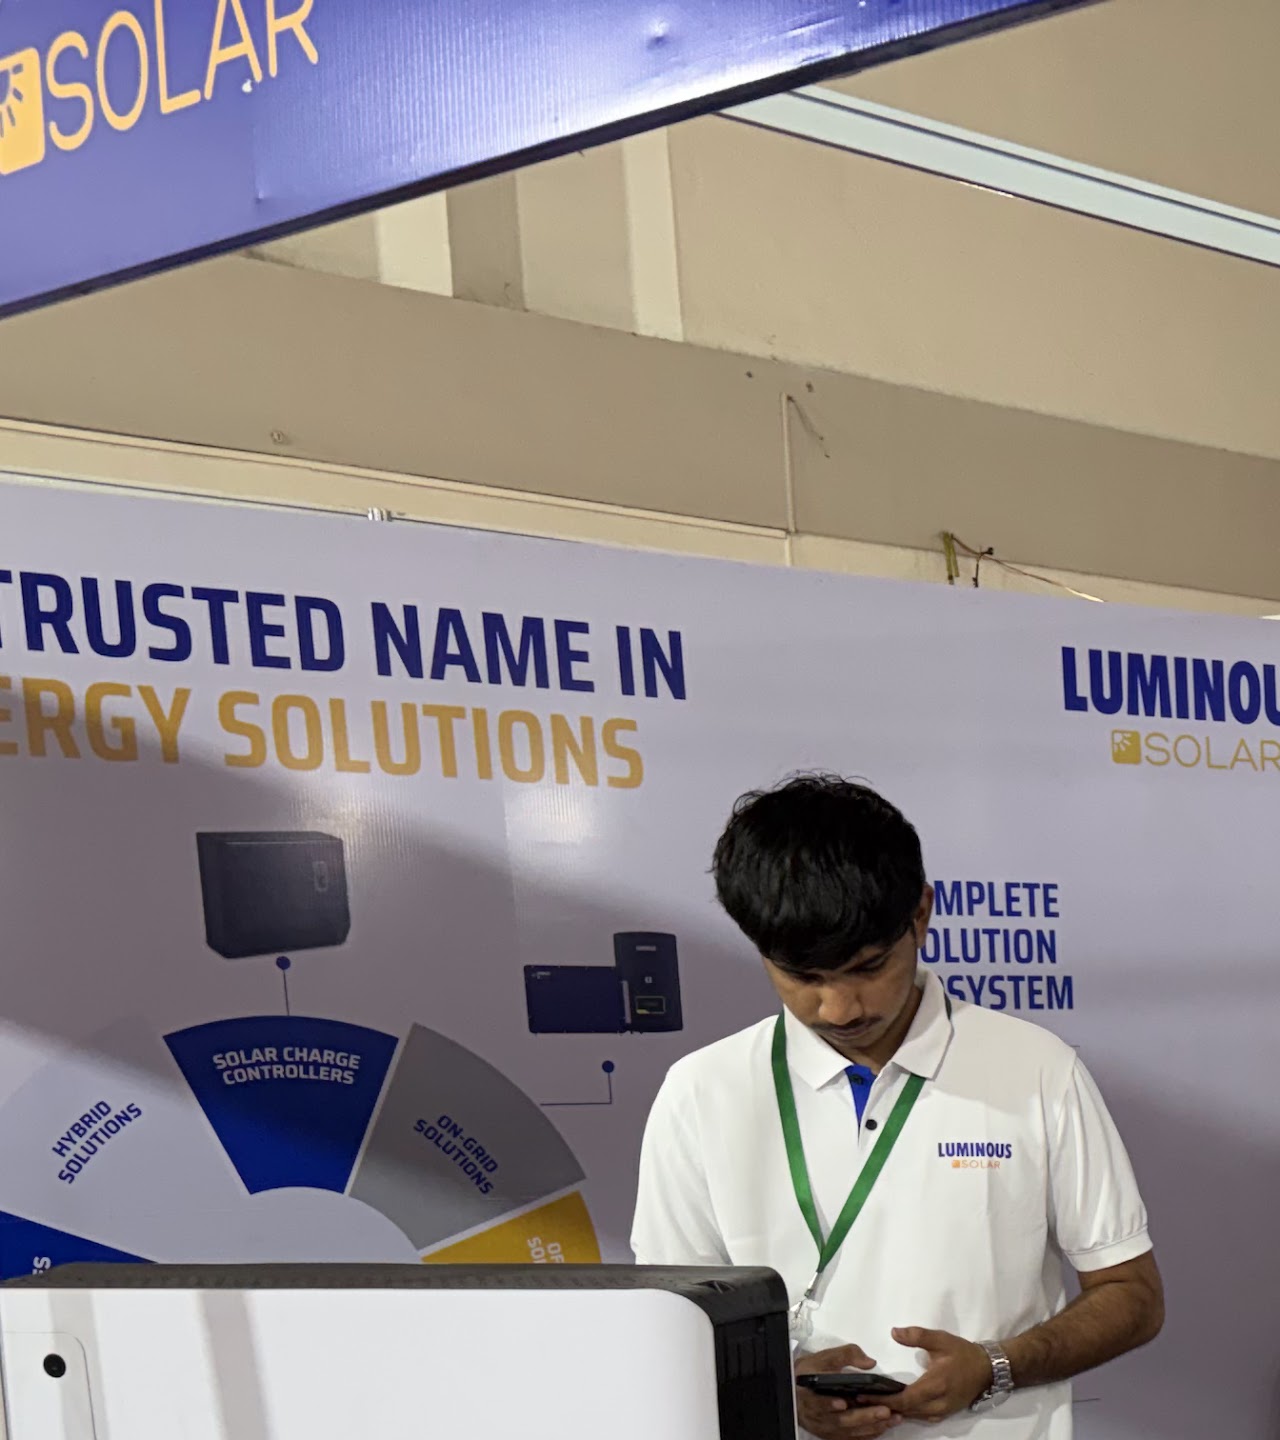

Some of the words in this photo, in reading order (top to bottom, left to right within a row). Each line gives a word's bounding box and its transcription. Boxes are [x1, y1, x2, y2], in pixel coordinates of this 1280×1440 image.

[45, 0, 320, 151] SOLAR
[371, 601, 595, 694] NAME
[616, 625, 687, 701] IN
[0, 675, 192, 765] RGY
[218, 689, 644, 791] SOLUTIONS
[934, 880, 1060, 918] MPLETE
[920, 928, 1057, 964] OLUTION
[947, 975, 1074, 1010] SYSTEM
[213, 1047, 279, 1070] SOLAR
[283, 1047, 362, 1070] CHARGE
[222, 1064, 356, 1085] CONTROLLERS
[52, 1100, 112, 1158] HYBRID
[58, 1103, 143, 1184] SOLUTIONS
[437, 1115, 499, 1174] ON-GRID
[937, 1142, 1012, 1159] LUMINOUS
[413, 1118, 495, 1195] SOLUTIONS
[961, 1159, 1001, 1170] SOLAR
